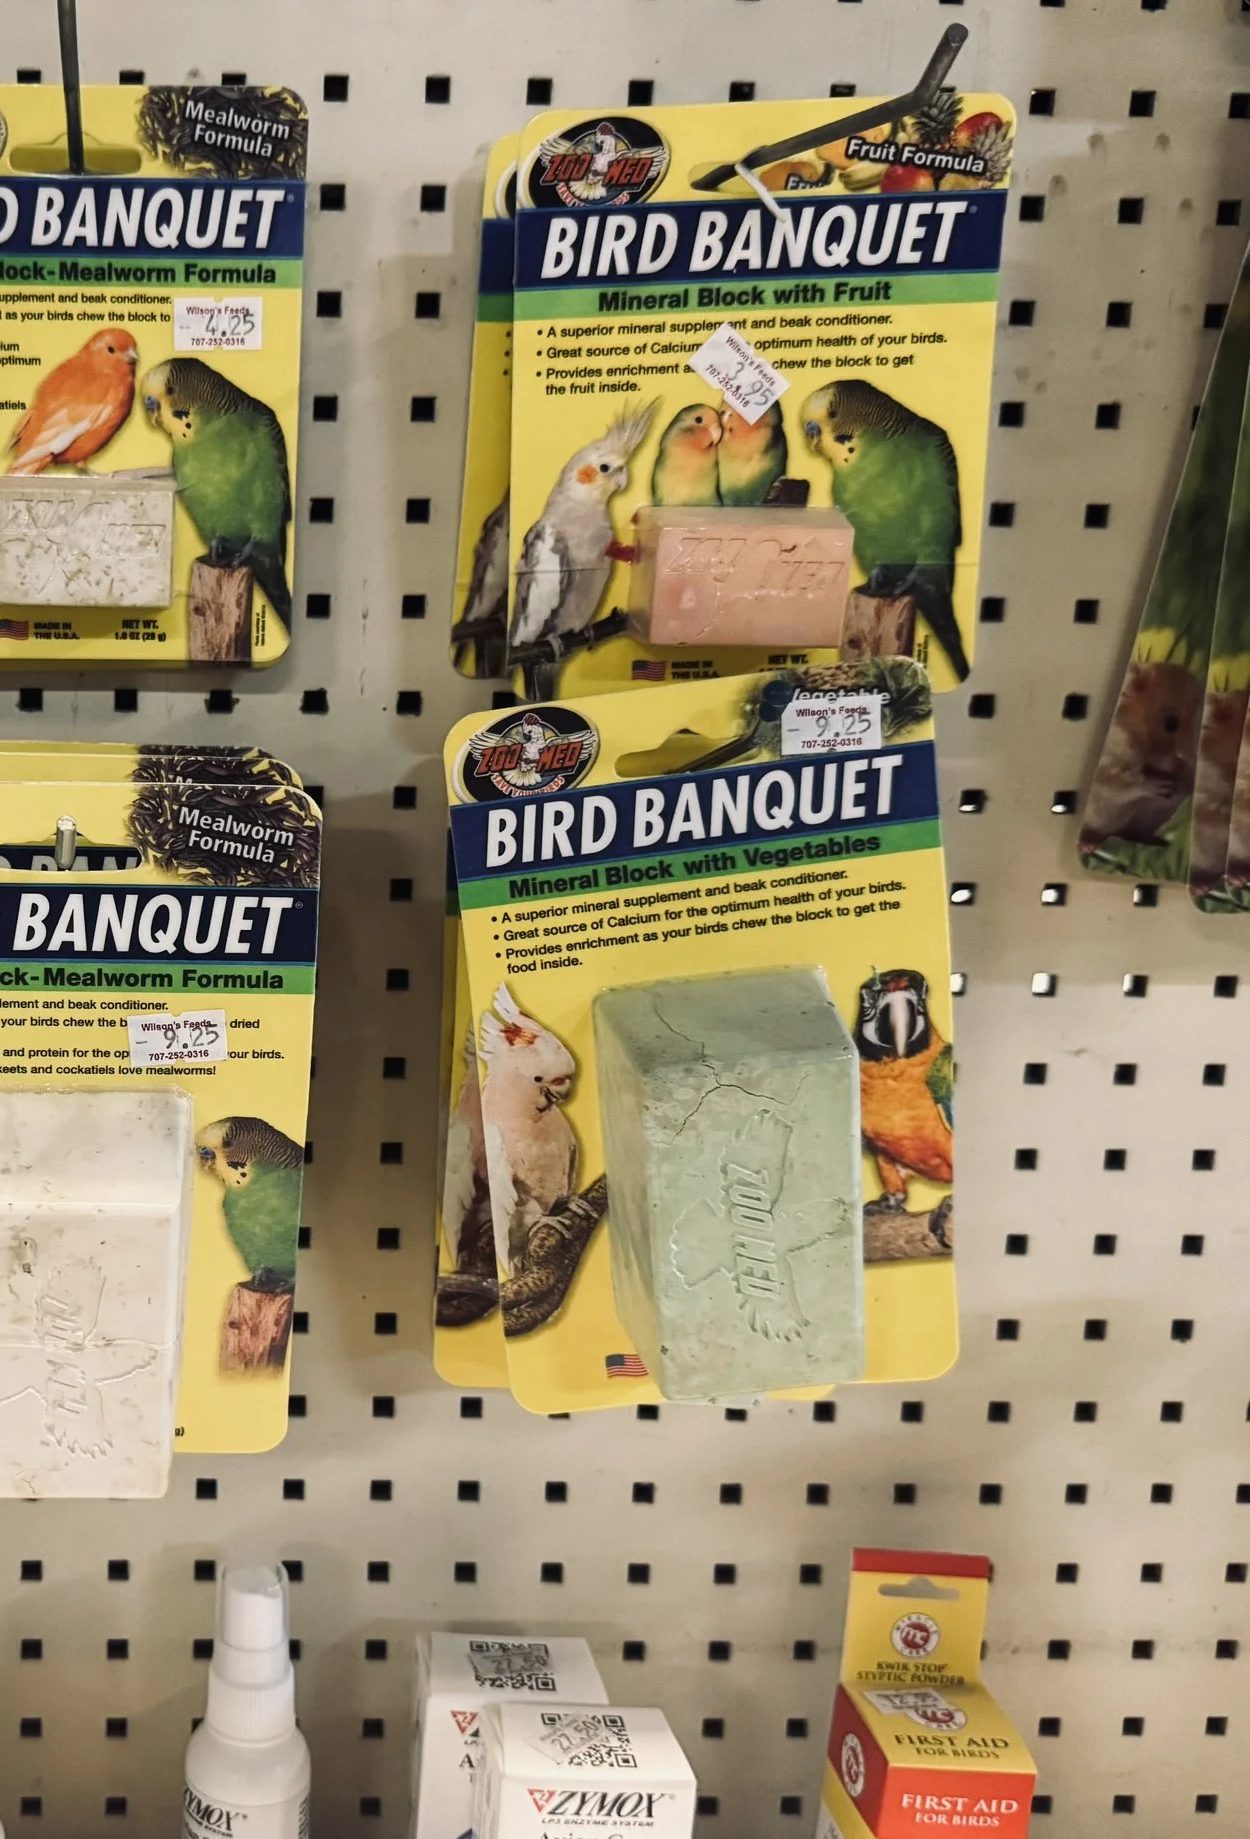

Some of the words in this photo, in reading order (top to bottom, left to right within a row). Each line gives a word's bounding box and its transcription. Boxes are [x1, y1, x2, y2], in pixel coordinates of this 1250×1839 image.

[185, 100, 290, 140] Mealworm
[194, 124, 273, 158] Formula
[848, 138, 896, 161] Fruit
[901, 147, 985, 173] Formula
[542, 153, 593, 184] ZOO
[602, 157, 654, 187] MED
[31, 186, 285, 249] BANQUET
[541, 212, 679, 279] BIRD
[689, 201, 968, 273] BANQUET
[184, 263, 276, 283] Formula
[598, 289, 688, 312] Mineral
[697, 286, 764, 307] Block
[773, 284, 825, 304] with
[834, 280, 892, 301] Fruit
[186, 306, 221, 315] Wilson's
[225, 306, 249, 315] Feeds
[205, 313, 255, 338] 4.25
[191, 337, 245, 347] 707-252-0316
[546, 384, 566, 395] the
[570, 382, 594, 394] fruit
[600, 382, 640, 393] inside.
[796, 708, 836, 718] Wilson's
[838, 705, 867, 715] Feeds
[814, 710, 872, 738] 9.25
[800, 738, 862, 749] 707-252-0316
[476, 744, 523, 775] ZOO
[536, 742, 583, 773] MED
[486, 795, 618, 868] BIRD
[633, 754, 902, 848] BANQUET
[178, 806, 294, 846] Mealworm
[188, 829, 275, 864] Formula
[508, 869, 599, 899] Mineral
[605, 860, 674, 886] Block
[683, 852, 736, 875] with
[743, 835, 881, 868] Vegetables
[501, 912, 512, 924] A
[514, 907, 568, 924] superior
[572, 898, 620, 914] mineral
[624, 889, 701, 909] supplement
[705, 883, 730, 898] and
[734, 880, 766, 894] beak
[770, 869, 848, 888] conditioner.
[12, 893, 294, 954] BANQUET
[507, 959, 536, 974] food
[540, 955, 583, 970] inside.
[182, 969, 284, 989] Formula
[42, 999, 64, 1009] and
[68, 999, 97, 1010] beak
[100, 1000, 168, 1010] conditioner.
[1, 1018, 27, 1028] your
[30, 1016, 60, 1027] birds
[63, 1017, 94, 1027] chew
[98, 1018, 117, 1027] the
[230, 1018, 260, 1029] dried
[141, 1022, 181, 1032] Wilson's
[184, 1020, 212, 1029] Feeds
[163, 1024, 220, 1050] 9.25
[148, 1050, 210, 1062] 707-252-0316
[30, 1064, 53, 1074] and
[56, 1065, 116, 1075] cockatiels
[118, 1065, 143, 1075] love
[146, 1065, 216, 1076] mealworms!
[895, 1734, 958, 1748] FIRST
[967, 1737, 1009, 1749] AID
[915, 1747, 947, 1757] FOR
[952, 1748, 1000, 1760] BIRDS
[547, 1790, 666, 1818] ZYMOX
[902, 1794, 969, 1812] FIRST
[973, 1798, 1018, 1814] AID
[915, 1813, 948, 1824] FOR
[952, 1814, 1000, 1827] BIRDS
